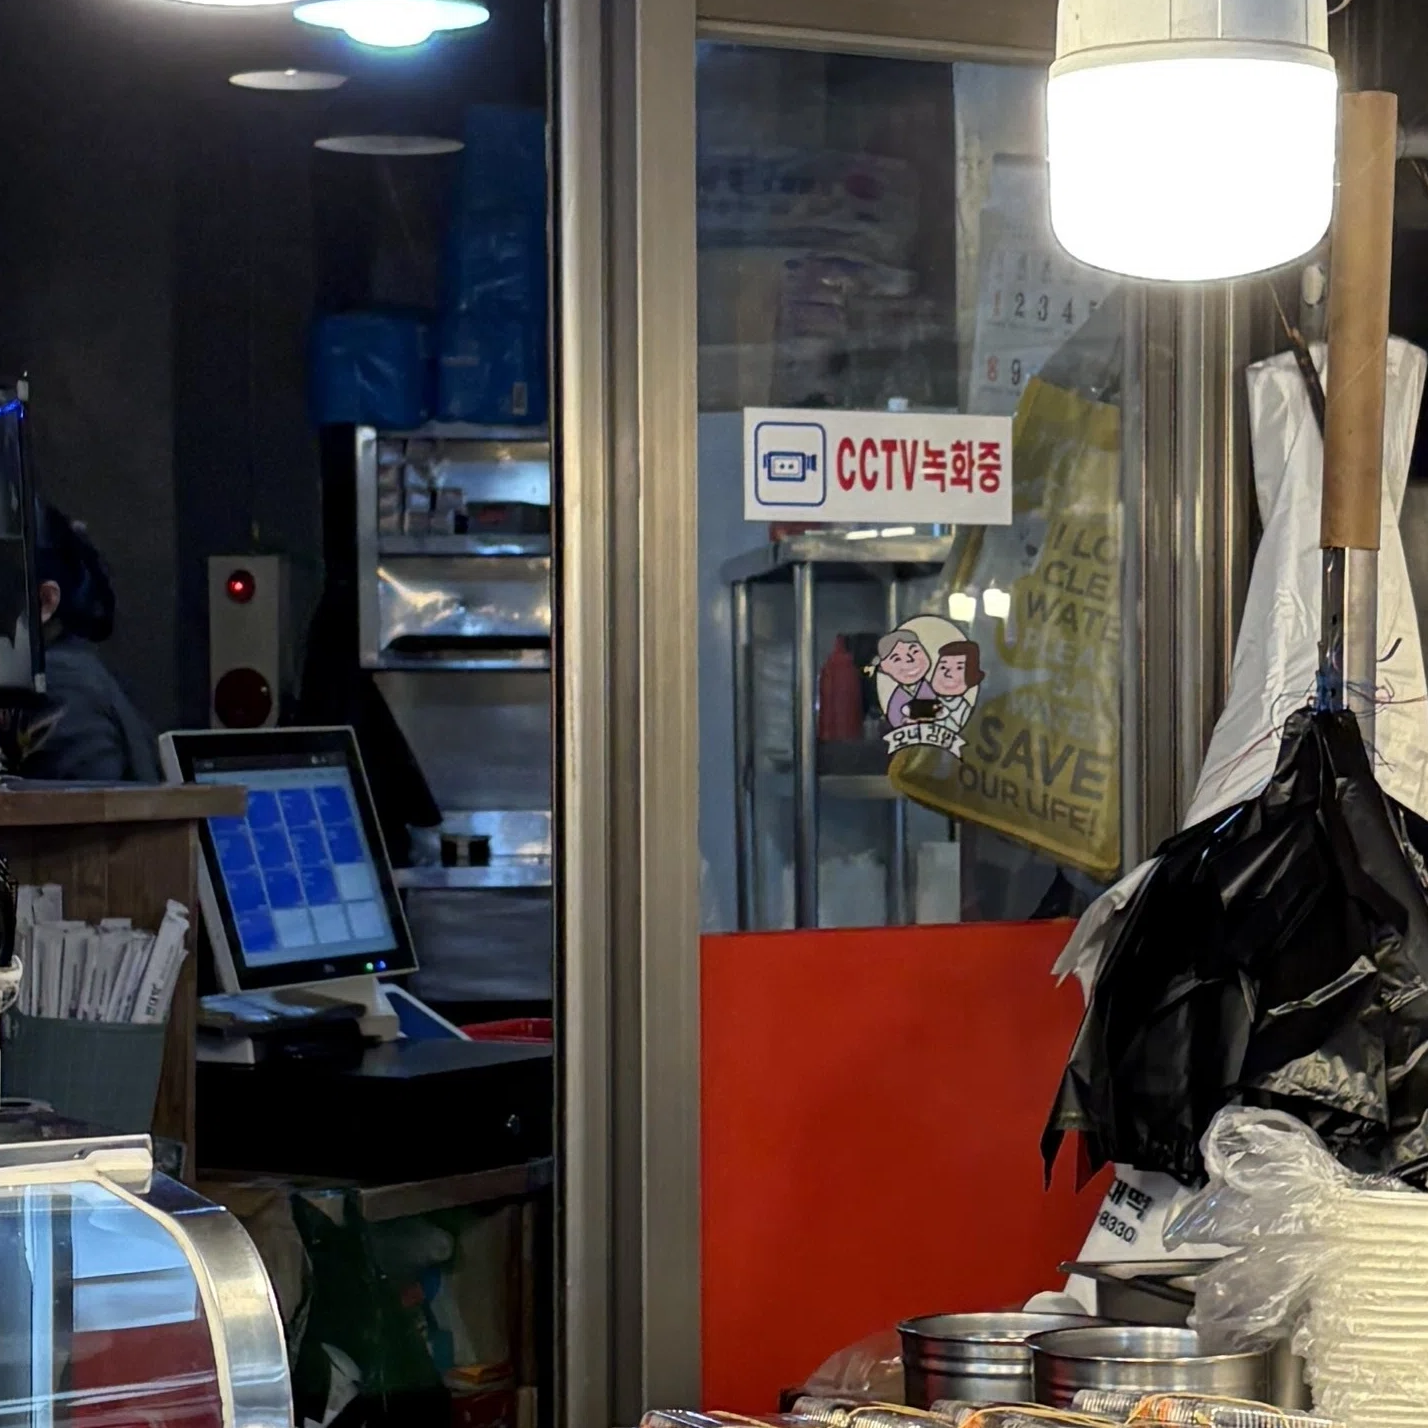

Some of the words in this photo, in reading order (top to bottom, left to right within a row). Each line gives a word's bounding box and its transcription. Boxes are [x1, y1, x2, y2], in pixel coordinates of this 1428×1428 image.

[1014, 291, 1026, 319] 2
[1037, 294, 1050, 322] 3
[975, 715, 1107, 801] SAVE
[957, 763, 1020, 809] OUR
[1098, 1209, 1137, 1244] 8330
